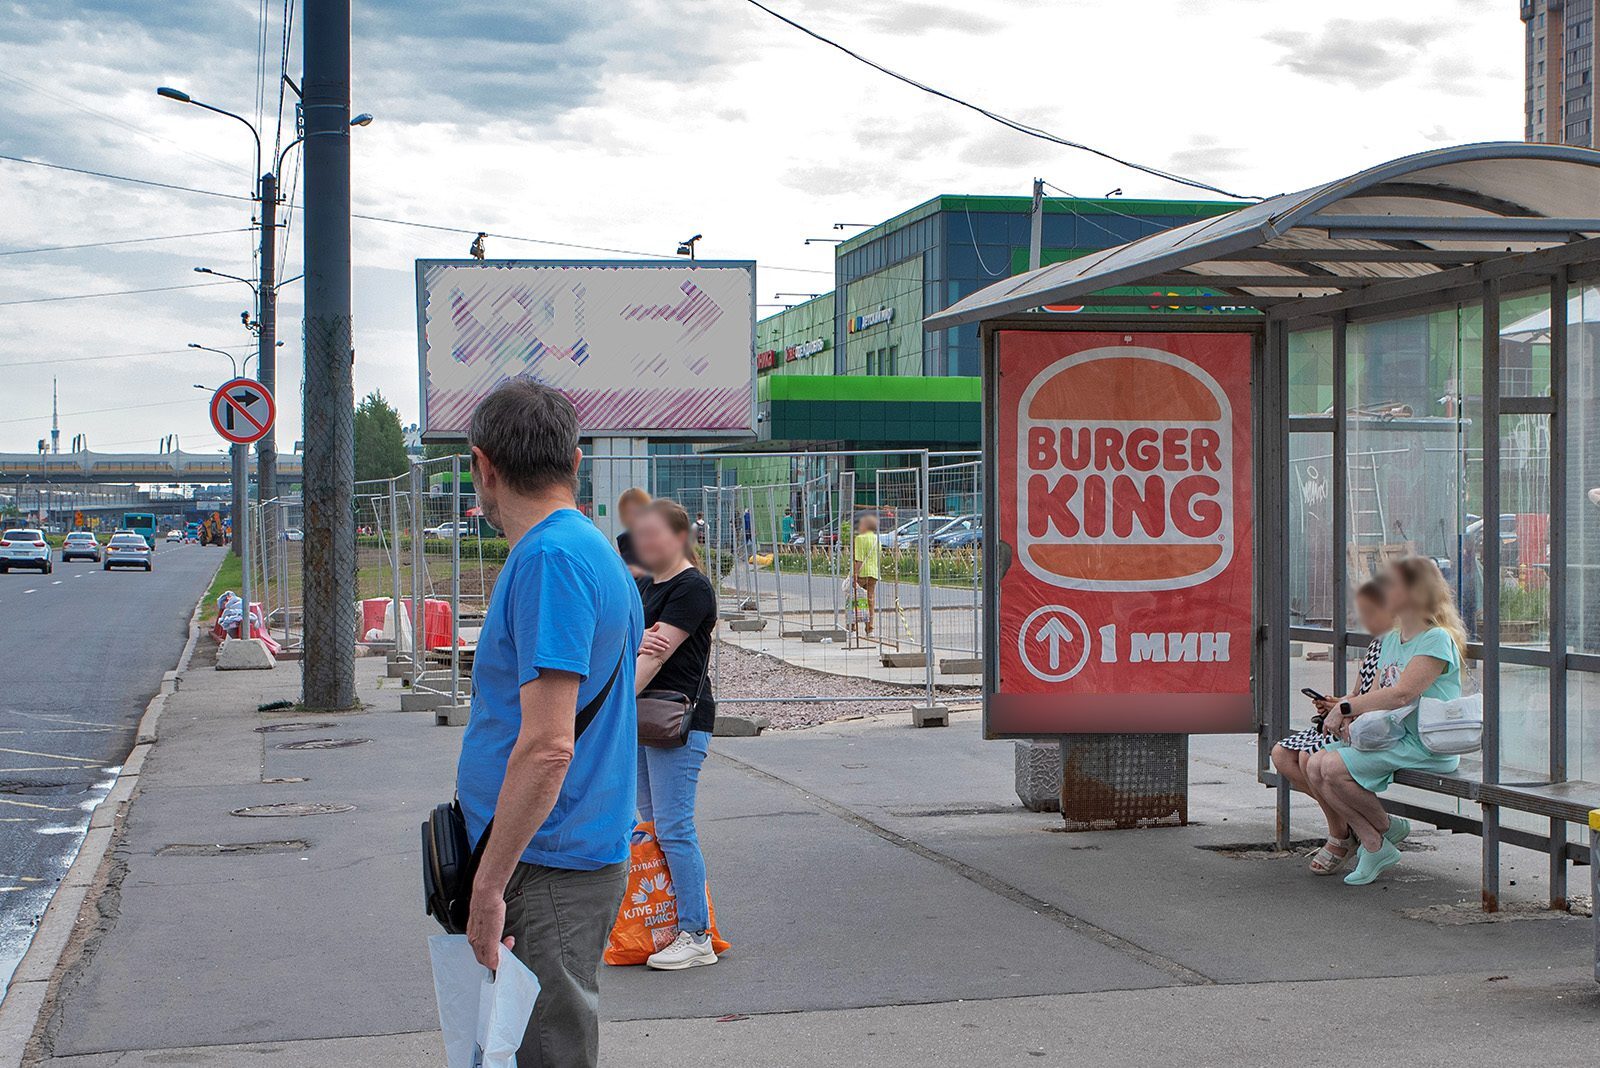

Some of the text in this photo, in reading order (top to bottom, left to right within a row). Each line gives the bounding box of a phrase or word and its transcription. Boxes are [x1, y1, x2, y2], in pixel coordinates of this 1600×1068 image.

[1028, 427, 1222, 472] BURGER
[1027, 474, 1223, 538] KING
[1099, 623, 1117, 663] 1
[624, 904, 652, 919] КЛУБ
